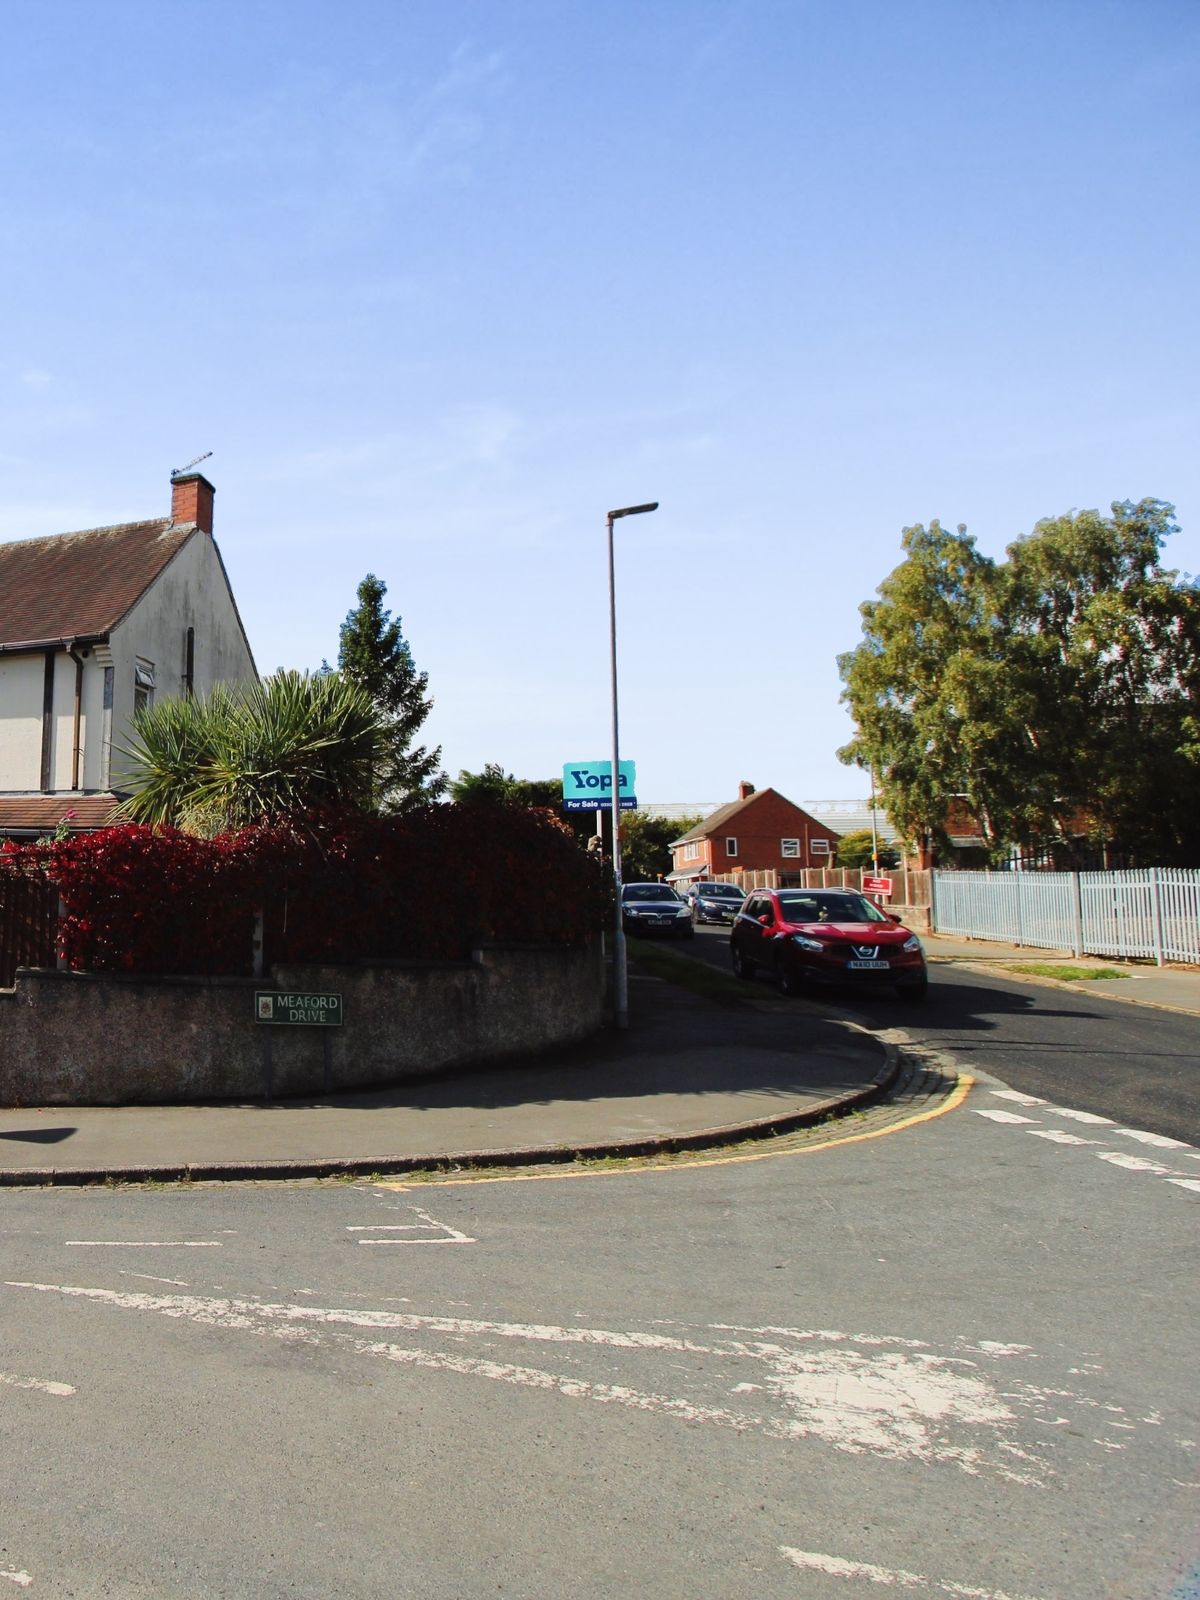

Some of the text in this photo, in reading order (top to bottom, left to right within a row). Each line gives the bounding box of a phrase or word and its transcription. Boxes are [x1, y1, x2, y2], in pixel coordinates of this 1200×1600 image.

[571, 770, 628, 791] Yopa
[582, 800, 598, 808] Sale
[277, 995, 338, 1009] MEAFORD
[289, 1010, 326, 1022] DRIVE
